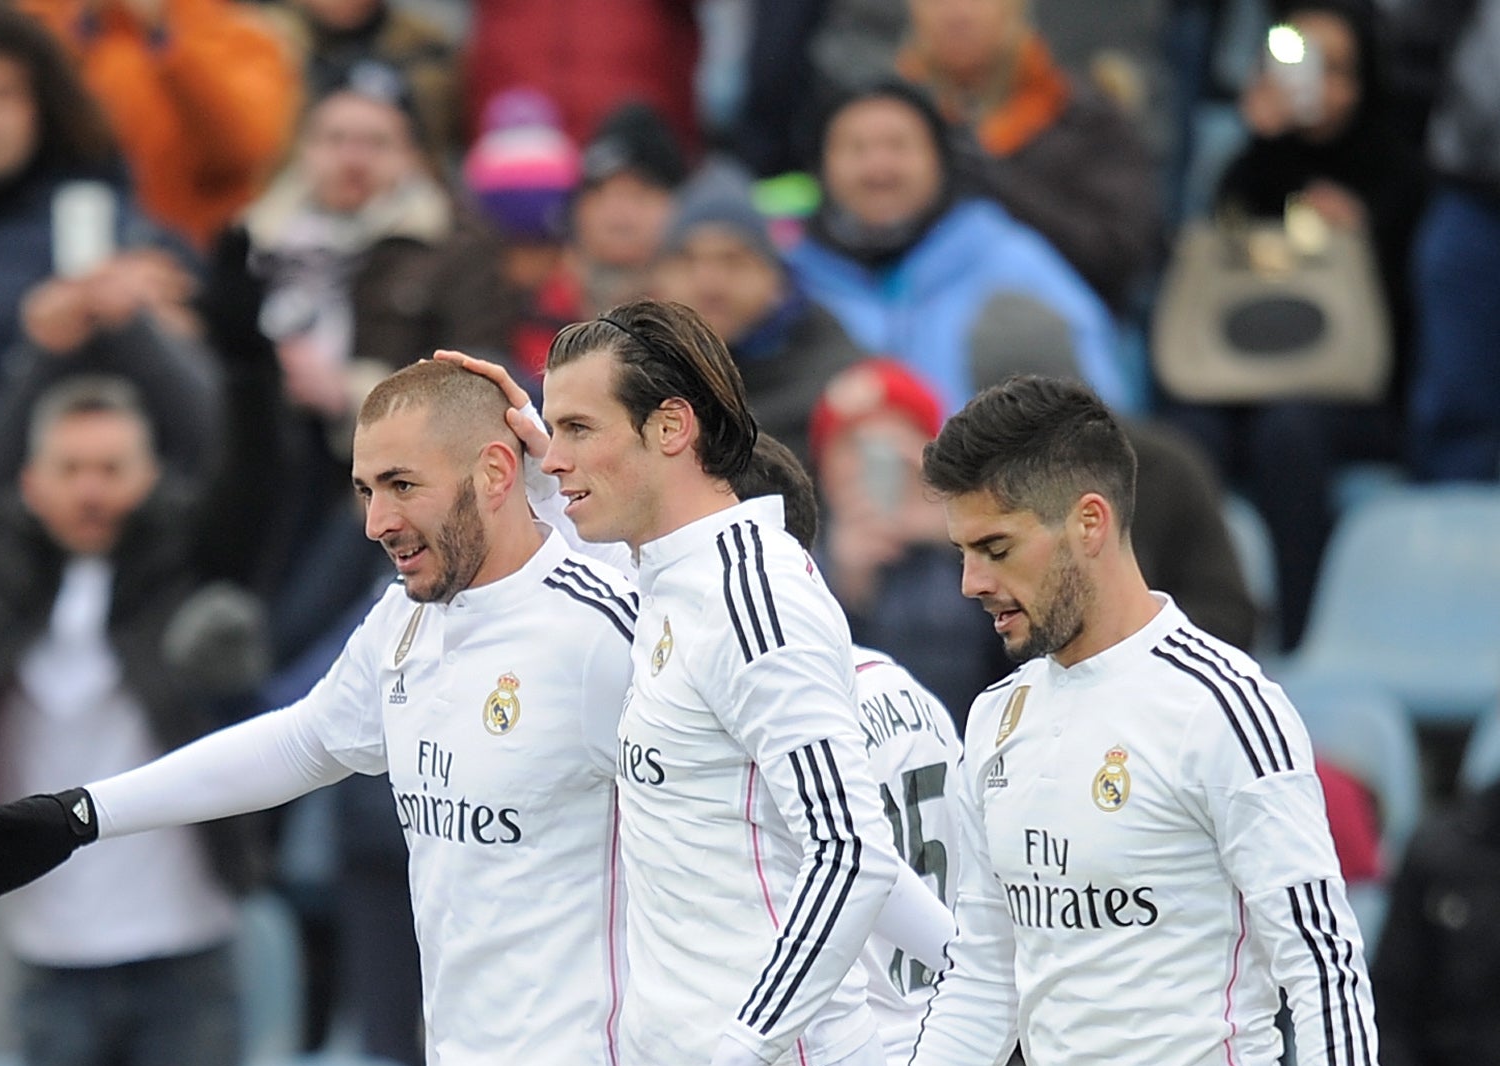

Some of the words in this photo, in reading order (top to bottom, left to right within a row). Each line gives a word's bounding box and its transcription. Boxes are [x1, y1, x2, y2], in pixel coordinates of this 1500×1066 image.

[418, 739, 453, 787] Fly
[397, 781, 522, 845] mirates
[1025, 828, 1069, 876] Fly
[1003, 872, 1159, 930] mirates
